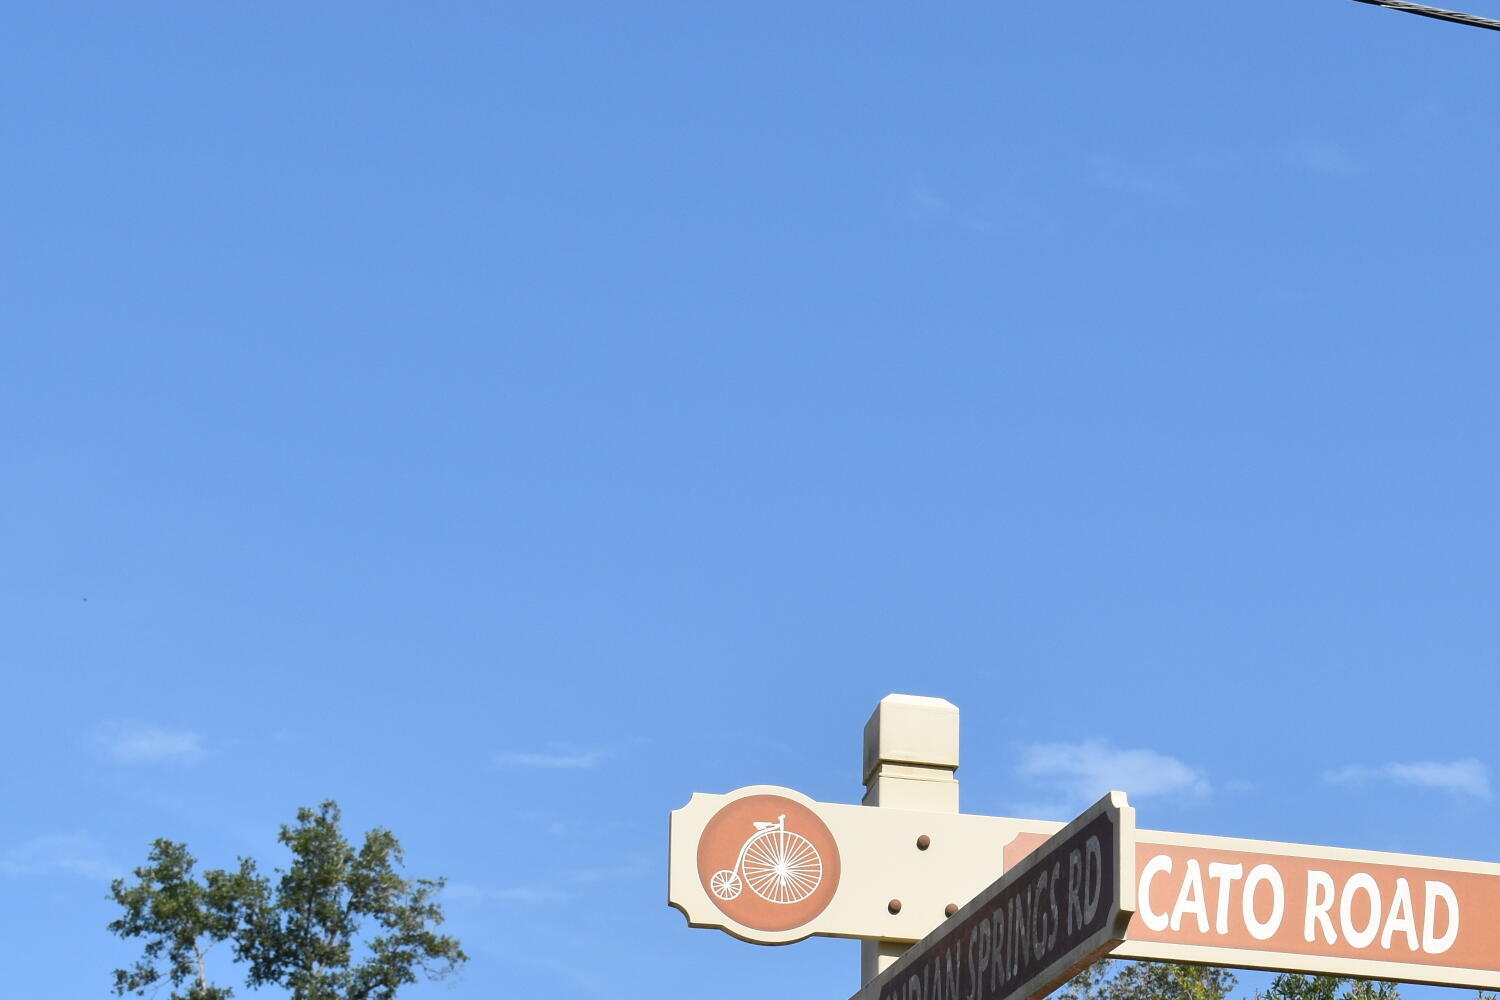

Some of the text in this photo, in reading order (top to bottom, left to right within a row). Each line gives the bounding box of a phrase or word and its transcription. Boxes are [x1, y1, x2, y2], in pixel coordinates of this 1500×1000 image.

[1066, 834, 1101, 936] RD
[1138, 854, 1460, 954] CATO ROAD
